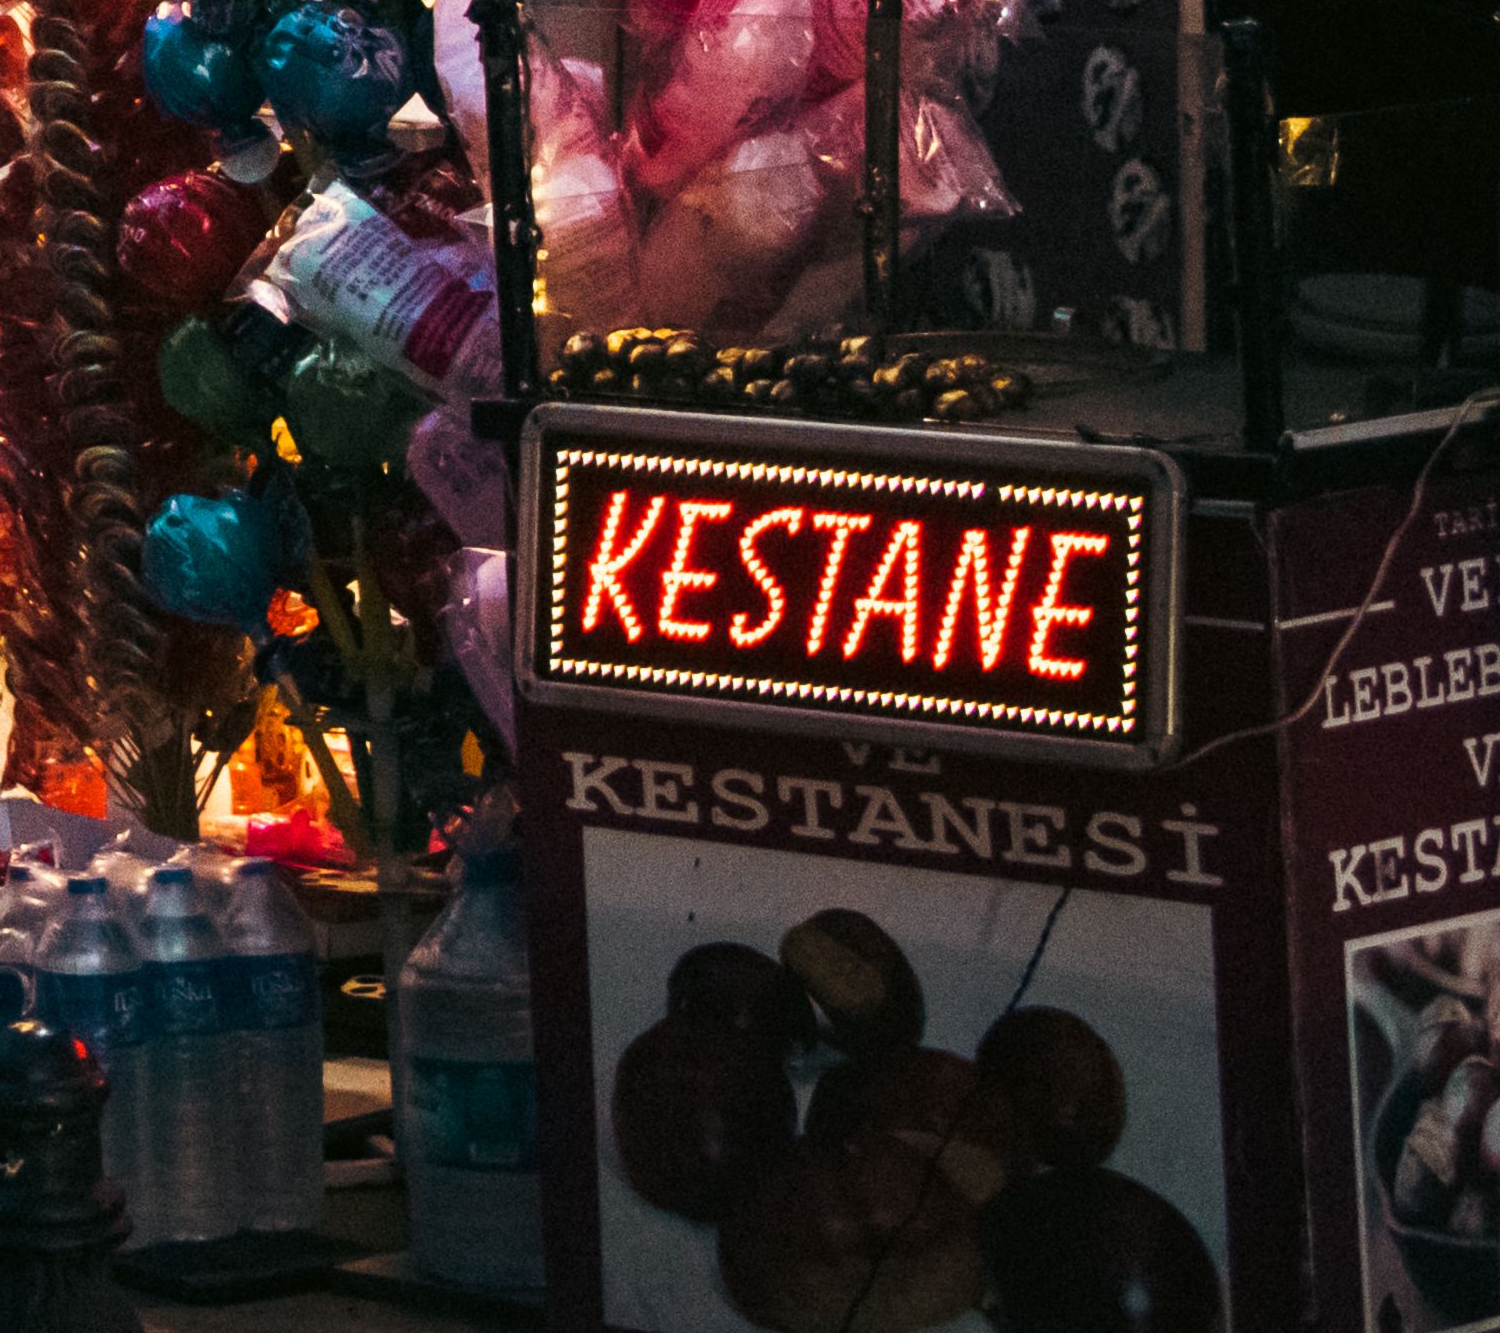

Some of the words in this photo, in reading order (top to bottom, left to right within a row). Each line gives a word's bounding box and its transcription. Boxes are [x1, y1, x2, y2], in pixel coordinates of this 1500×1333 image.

[582, 488, 1110, 680] KESTANE
[561, 751, 1224, 886] KESTANESİ
[1329, 815, 1500, 913] KEST
